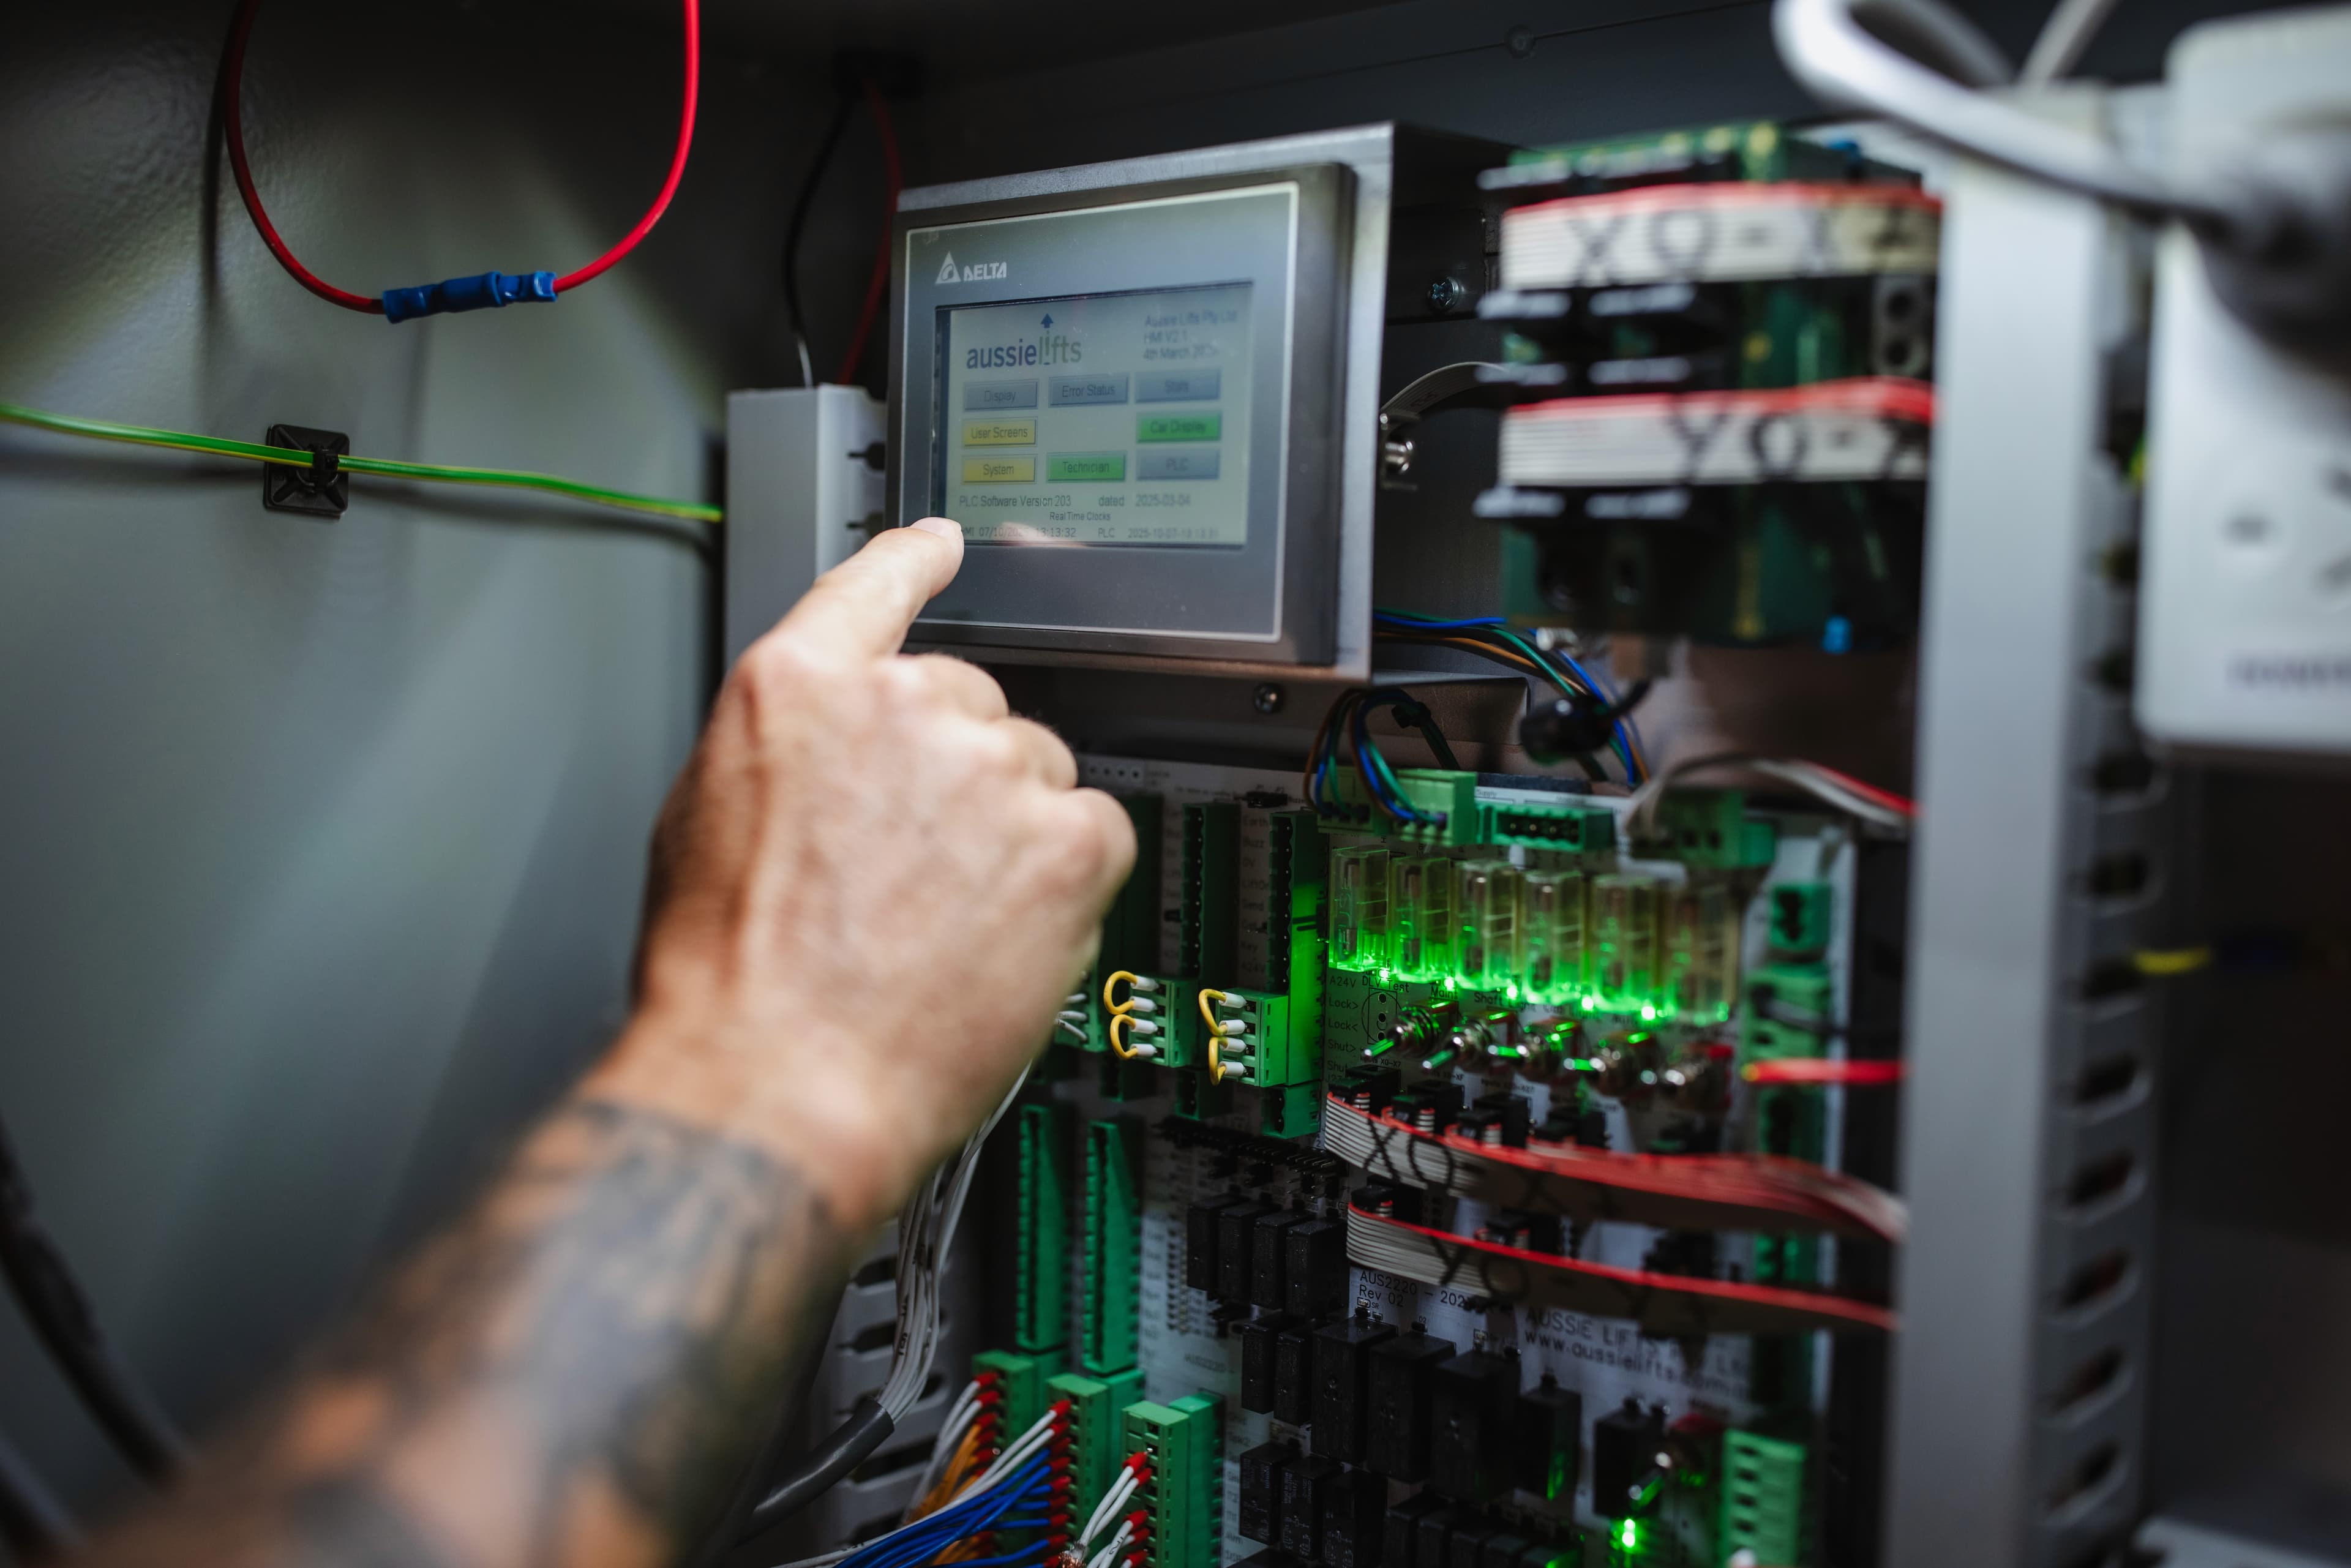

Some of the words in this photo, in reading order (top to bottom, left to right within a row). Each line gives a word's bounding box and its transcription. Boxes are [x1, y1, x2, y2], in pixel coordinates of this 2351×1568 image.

[963, 261, 1007, 282] DELTA
[984, 389, 1016, 403] Display
[1062, 384, 1084, 398] Error
[1087, 383, 1116, 397] Status
[971, 427, 990, 440] User
[992, 426, 1028, 439] Screens
[983, 463, 1014, 478] System
[1063, 460, 1109, 473] Technician
[959, 495, 978, 507] PLC
[981, 494, 1017, 507] Software
[1019, 495, 1052, 507] Version
[1054, 494, 1071, 507] 203
[1098, 494, 1125, 507] dated
[1049, 511, 1066, 522] Real
[1067, 511, 1085, 522] Time
[1087, 511, 1111, 521] Clocks
[1098, 527, 1115, 538] PLC
[1330, 976, 1356, 988] A24V
[1362, 975, 1381, 988] DLV
[1387, 980, 1409, 992] Test
[1431, 985, 1458, 1000] Maint
[1381, 1058, 1401, 1068] X0-X7
[1360, 1270, 1417, 1295] AUS2220
[1359, 1284, 1382, 1300] Rev
[1388, 1291, 1403, 1307] 02
[1525, 1306, 1593, 1339] AUSSIE
